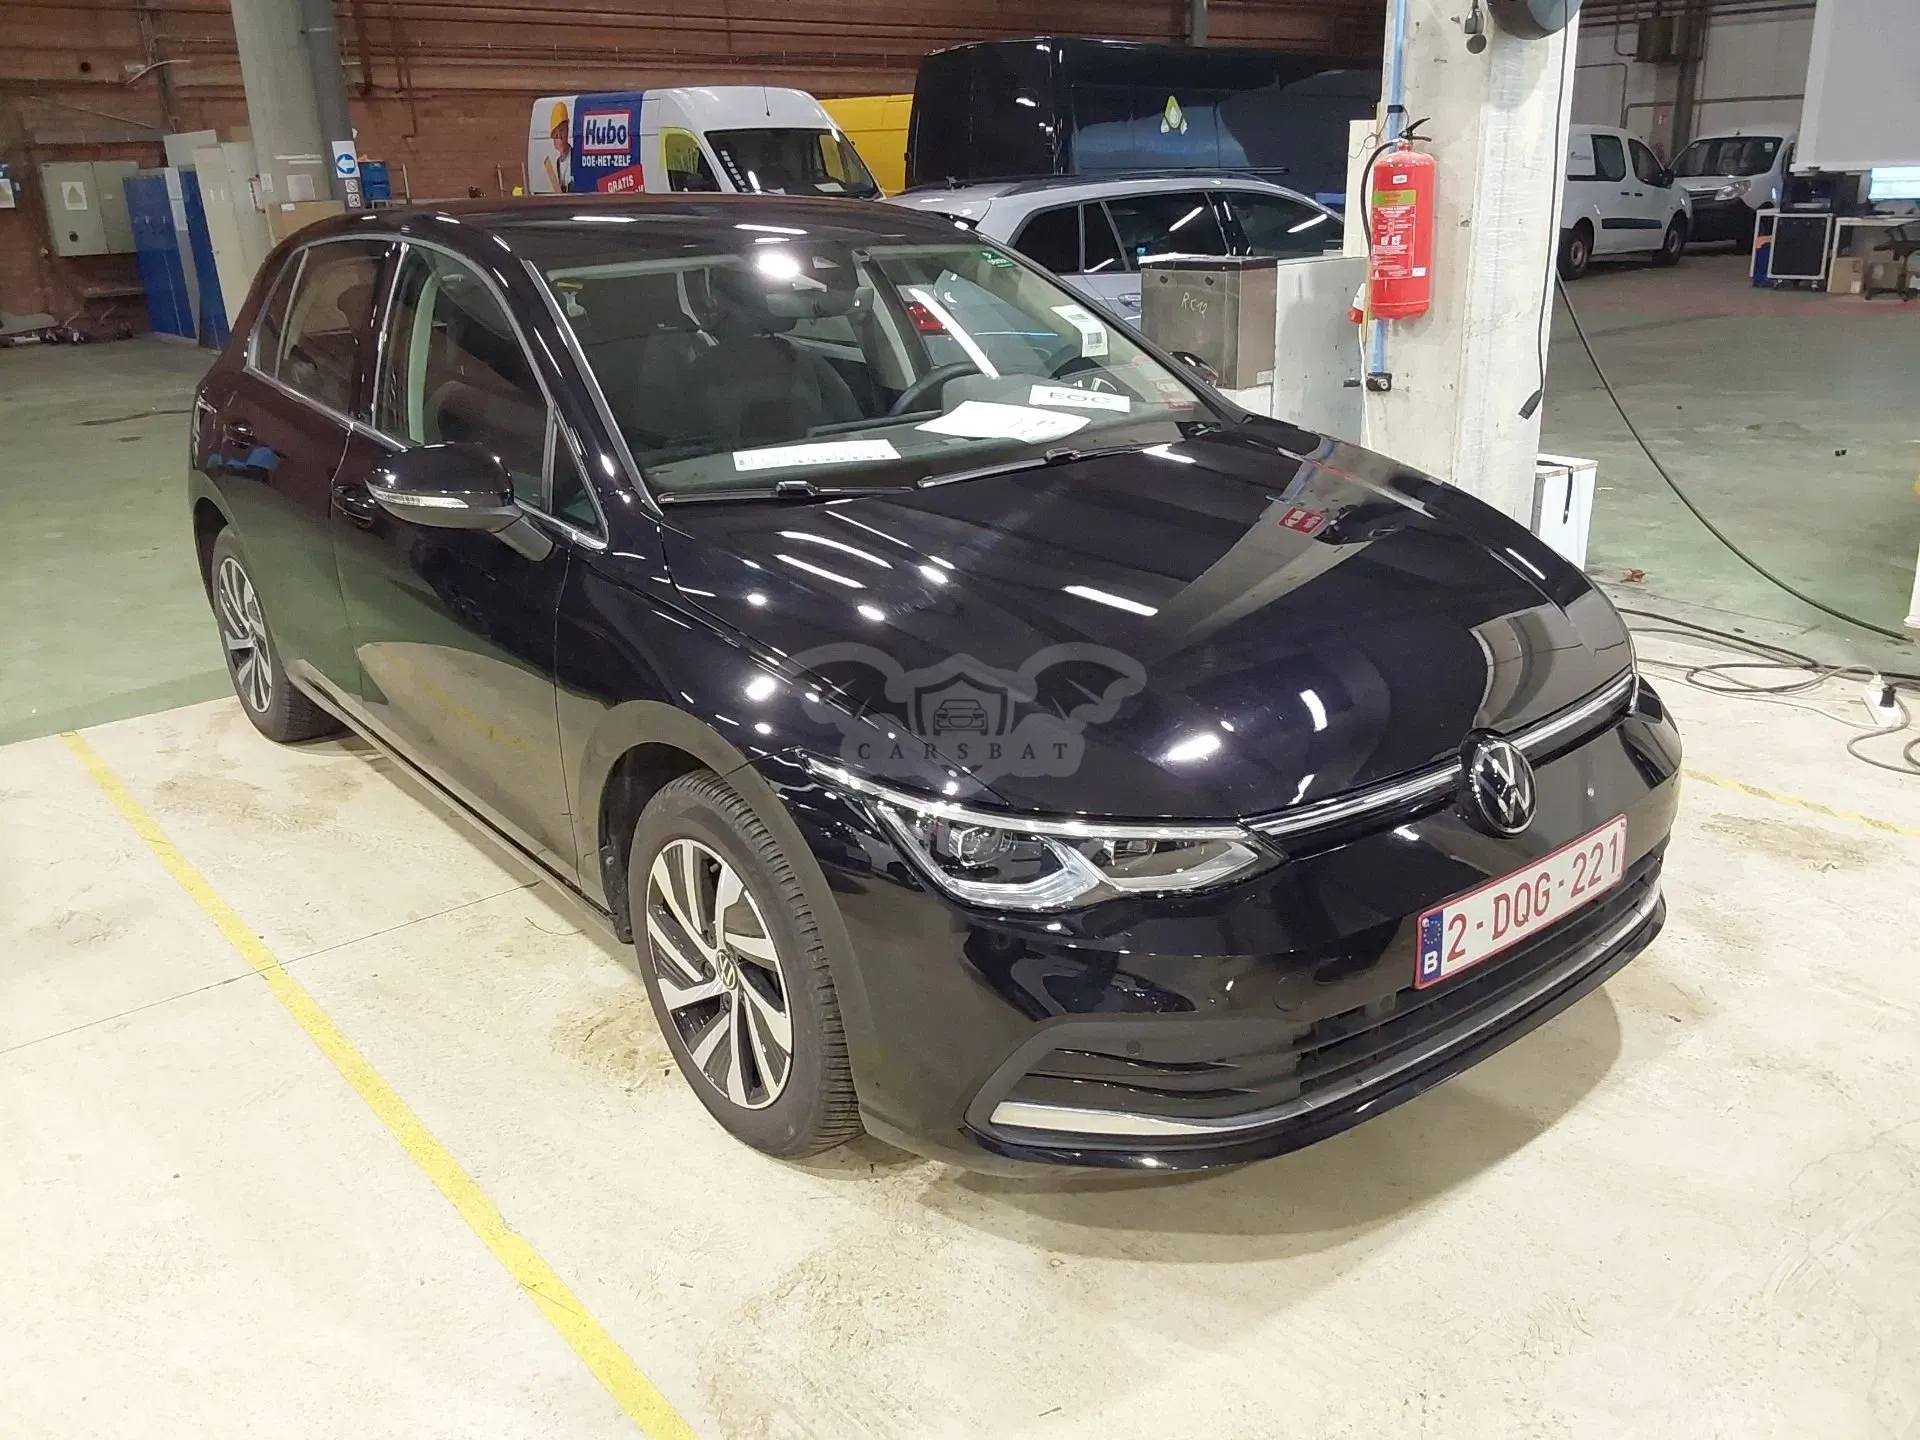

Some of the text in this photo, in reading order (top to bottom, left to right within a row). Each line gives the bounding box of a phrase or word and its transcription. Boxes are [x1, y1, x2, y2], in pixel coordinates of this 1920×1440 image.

[585, 118, 627, 146] Hubo
[607, 174, 634, 193] GRATIS
[1424, 831, 1619, 975] B 2-DQG-221
